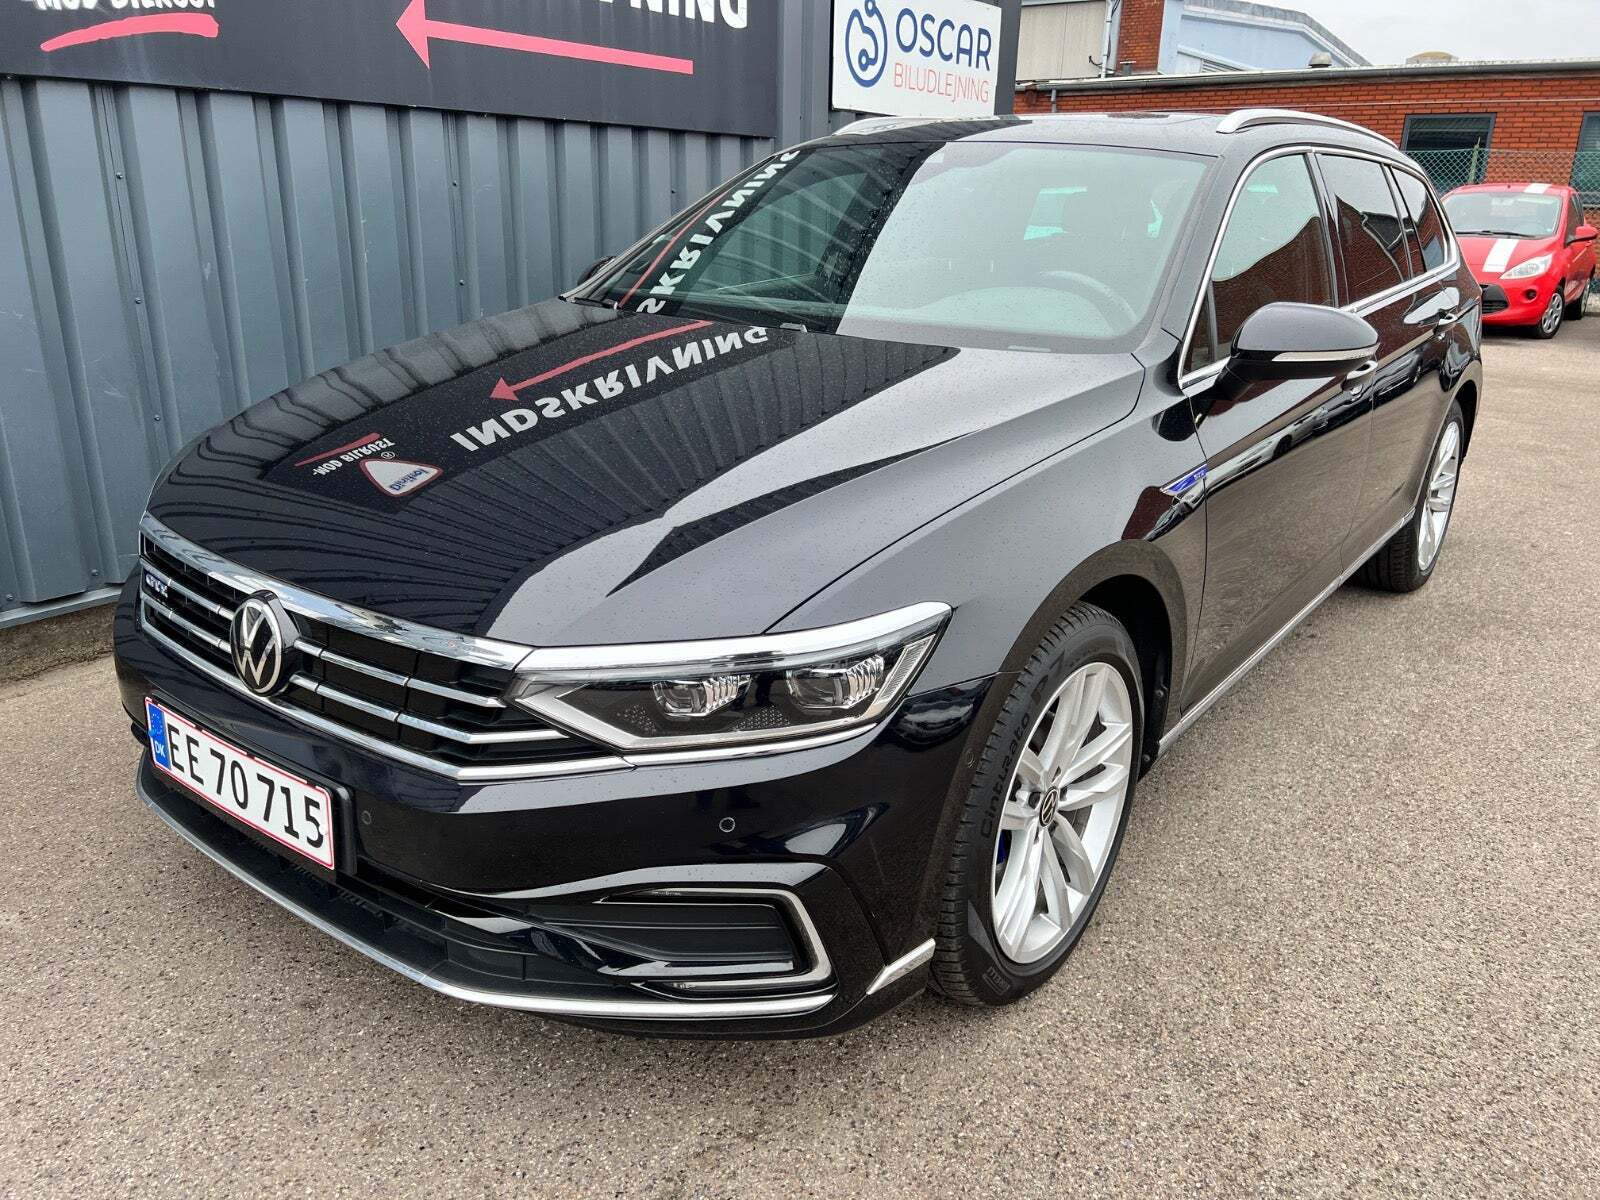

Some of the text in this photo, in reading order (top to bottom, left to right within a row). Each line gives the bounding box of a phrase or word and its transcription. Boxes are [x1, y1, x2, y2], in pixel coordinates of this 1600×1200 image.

[895, 7, 992, 71] OSCAR
[893, 62, 990, 103] BILUDLEJNING
[154, 741, 166, 759] DK
[168, 728, 324, 849] EE 70 715
